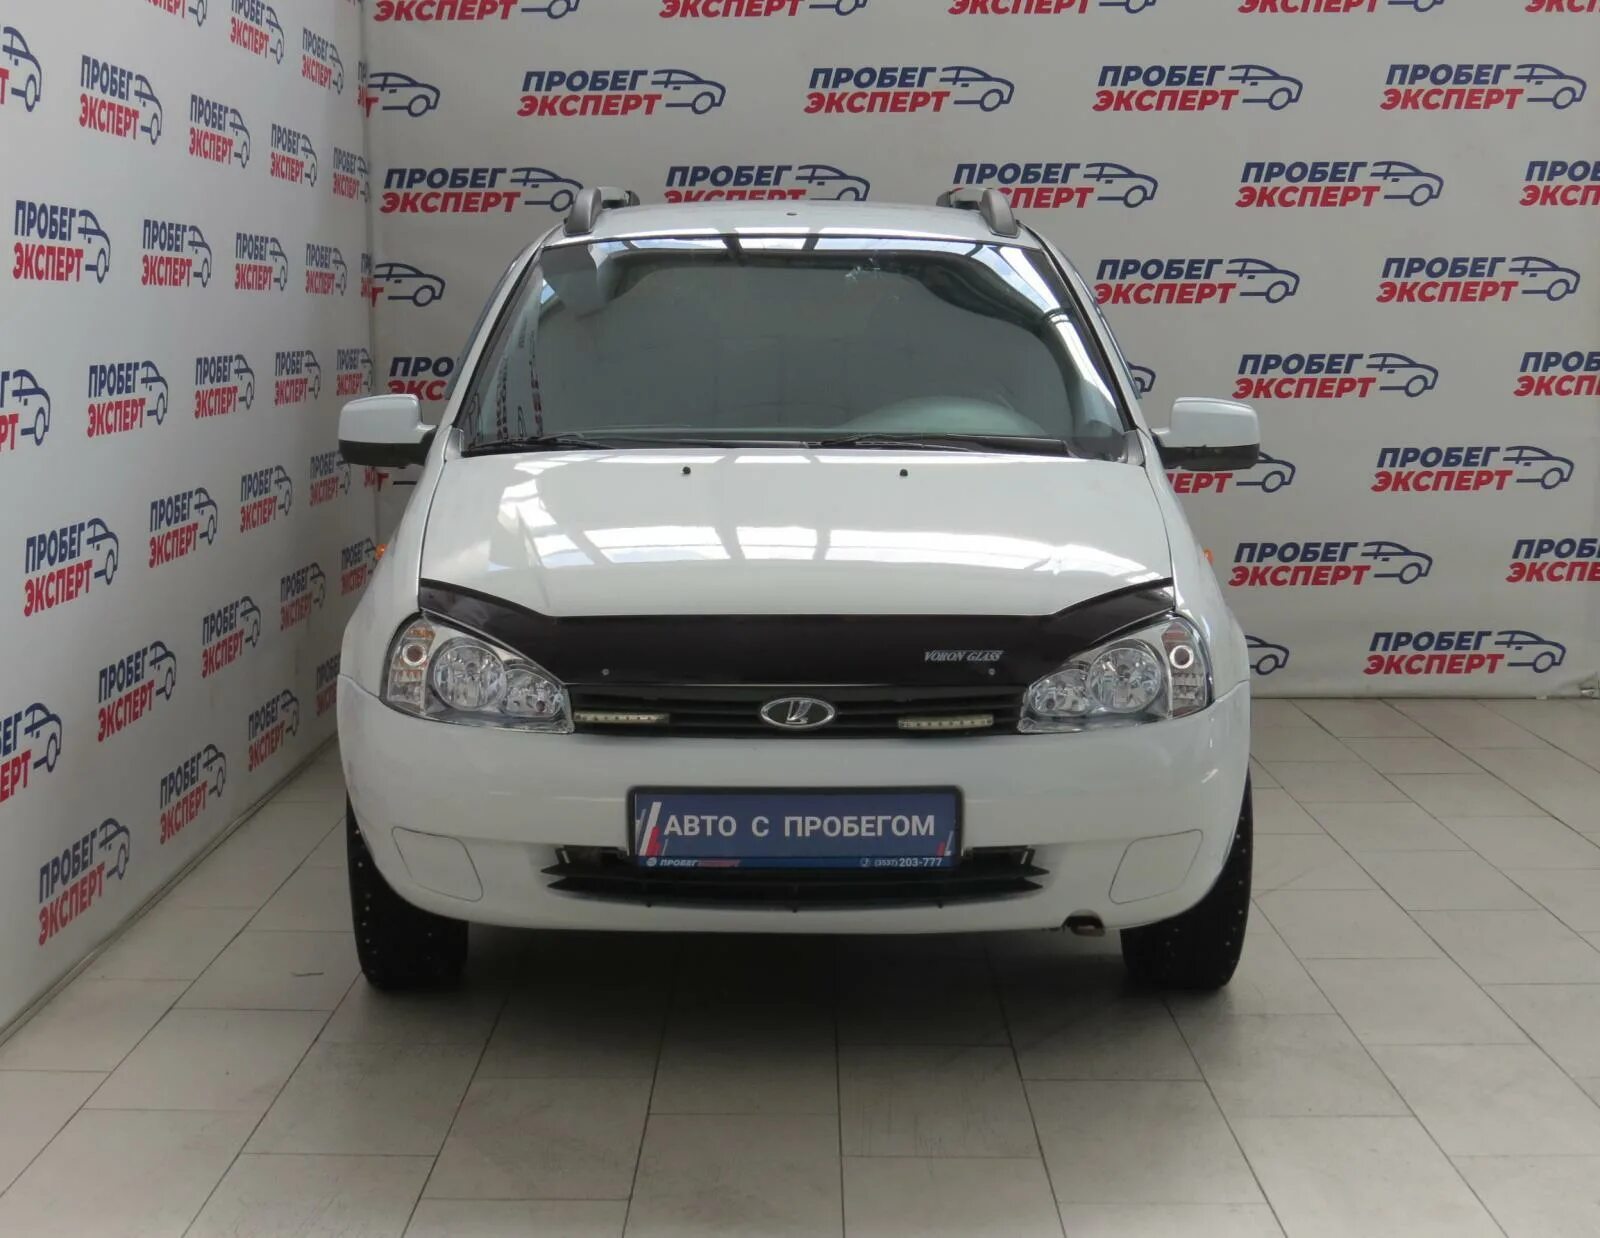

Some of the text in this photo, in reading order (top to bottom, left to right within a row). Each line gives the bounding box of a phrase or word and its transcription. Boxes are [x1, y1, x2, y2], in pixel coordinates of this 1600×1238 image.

[374, 0, 518, 21] ЭКСПЕРТ
[659, 0, 801, 18] ЭКСПЕРТ
[230, 16, 269, 58] ЭКСПЕРТ
[81, 54, 133, 97] ПРОБЕГ
[522, 70, 648, 92] ПРОБЕГ
[809, 67, 937, 89] ПРОБЕГ
[1098, 65, 1226, 87] ПРОБЕГ
[1385, 64, 1512, 85] ПРОБЕГ
[518, 93, 663, 117] ЭКСПЕРТ
[805, 90, 951, 113] ЭКСПЕРТ
[1093, 89, 1241, 111] ЭКСПЕРТ
[1381, 87, 1525, 110] ЭКСПЕРТ
[79, 94, 139, 140] ЭКСПЕРТ
[190, 94, 229, 131] ПРОБЕГ
[189, 129, 233, 165] ЭКСПЕРТ
[384, 168, 507, 189] ПРОБЕГ
[666, 165, 792, 187] ПРОБЕГ
[953, 163, 1081, 184] ПРОБЕГ
[1241, 162, 1368, 183] ПРОБЕГ
[383, 192, 522, 213] ЭКСПЕРТ
[1000, 186, 1095, 208] ПЕРТ
[1236, 185, 1381, 208] ЭКСПЕРТ
[1520, 184, 1600, 206] ЭКСП
[14, 200, 76, 241] ПРОБЕГ
[143, 219, 187, 252] ПРОБЕГ
[12, 243, 84, 282] ЭКСПЕРТ
[141, 255, 192, 287] ЭКСПЕРТ
[1096, 259, 1224, 280] ПРОБЕГ
[1382, 257, 1506, 278] ПРОБЕГ
[235, 264, 272, 290] ЭКСПЕРТ
[1095, 282, 1237, 304] ЭКСПЕРТ
[1376, 280, 1520, 303] ЭКСПЕРТ
[195, 355, 233, 385] ПРОБЕГ
[1238, 353, 1364, 375] ПРОБЕГ
[1520, 351, 1600, 372] ПРОБ
[88, 362, 139, 398] ПРОБЕГ
[1232, 376, 1376, 399] ЭКСПЕРТ
[1514, 374, 1600, 398] ЭКСП
[194, 386, 238, 418] ЭКСПЕРТ
[87, 398, 146, 438] ЭКСПЕРТ
[1376, 446, 1501, 468] ПРОБЕГ
[1372, 469, 1514, 493] ЭКСПЕРТ
[150, 491, 193, 532] ПРОБЕГ
[240, 496, 278, 532] ЭКСПЕРТ
[25, 522, 85, 574] ПРОБЕГ
[149, 523, 199, 568] ЭКСПЕРТ
[1234, 542, 1359, 563] ПРОБЕГ
[1512, 538, 1600, 559] ПРОБ
[1230, 565, 1372, 587] ЭКСПЕРТ
[1506, 561, 1600, 583] ЭКСПЕ
[24, 559, 94, 616] ЭКСПЕРТ
[203, 601, 239, 645] ПРОБЕГ
[1369, 631, 1492, 651] ПРОБЕГ
[202, 629, 244, 678] ЭКСПЕРТ
[1365, 653, 1504, 675] ЭКСПЕРТ
[98, 647, 148, 703] ПРОБЕГ
[98, 681, 155, 742] ЭКСПЕРТ
[248, 724, 285, 772] ЭКСПЕРТ
[160, 751, 201, 809] ПРОБЕГ
[159, 781, 208, 845] ЭКСПЕРТ
[664, 815, 935, 837] АВТО С ПРОБЕГОМ
[39, 828, 97, 903] ПРОБЕГ
[38, 863, 105, 946] ЭКСПЕРТ
